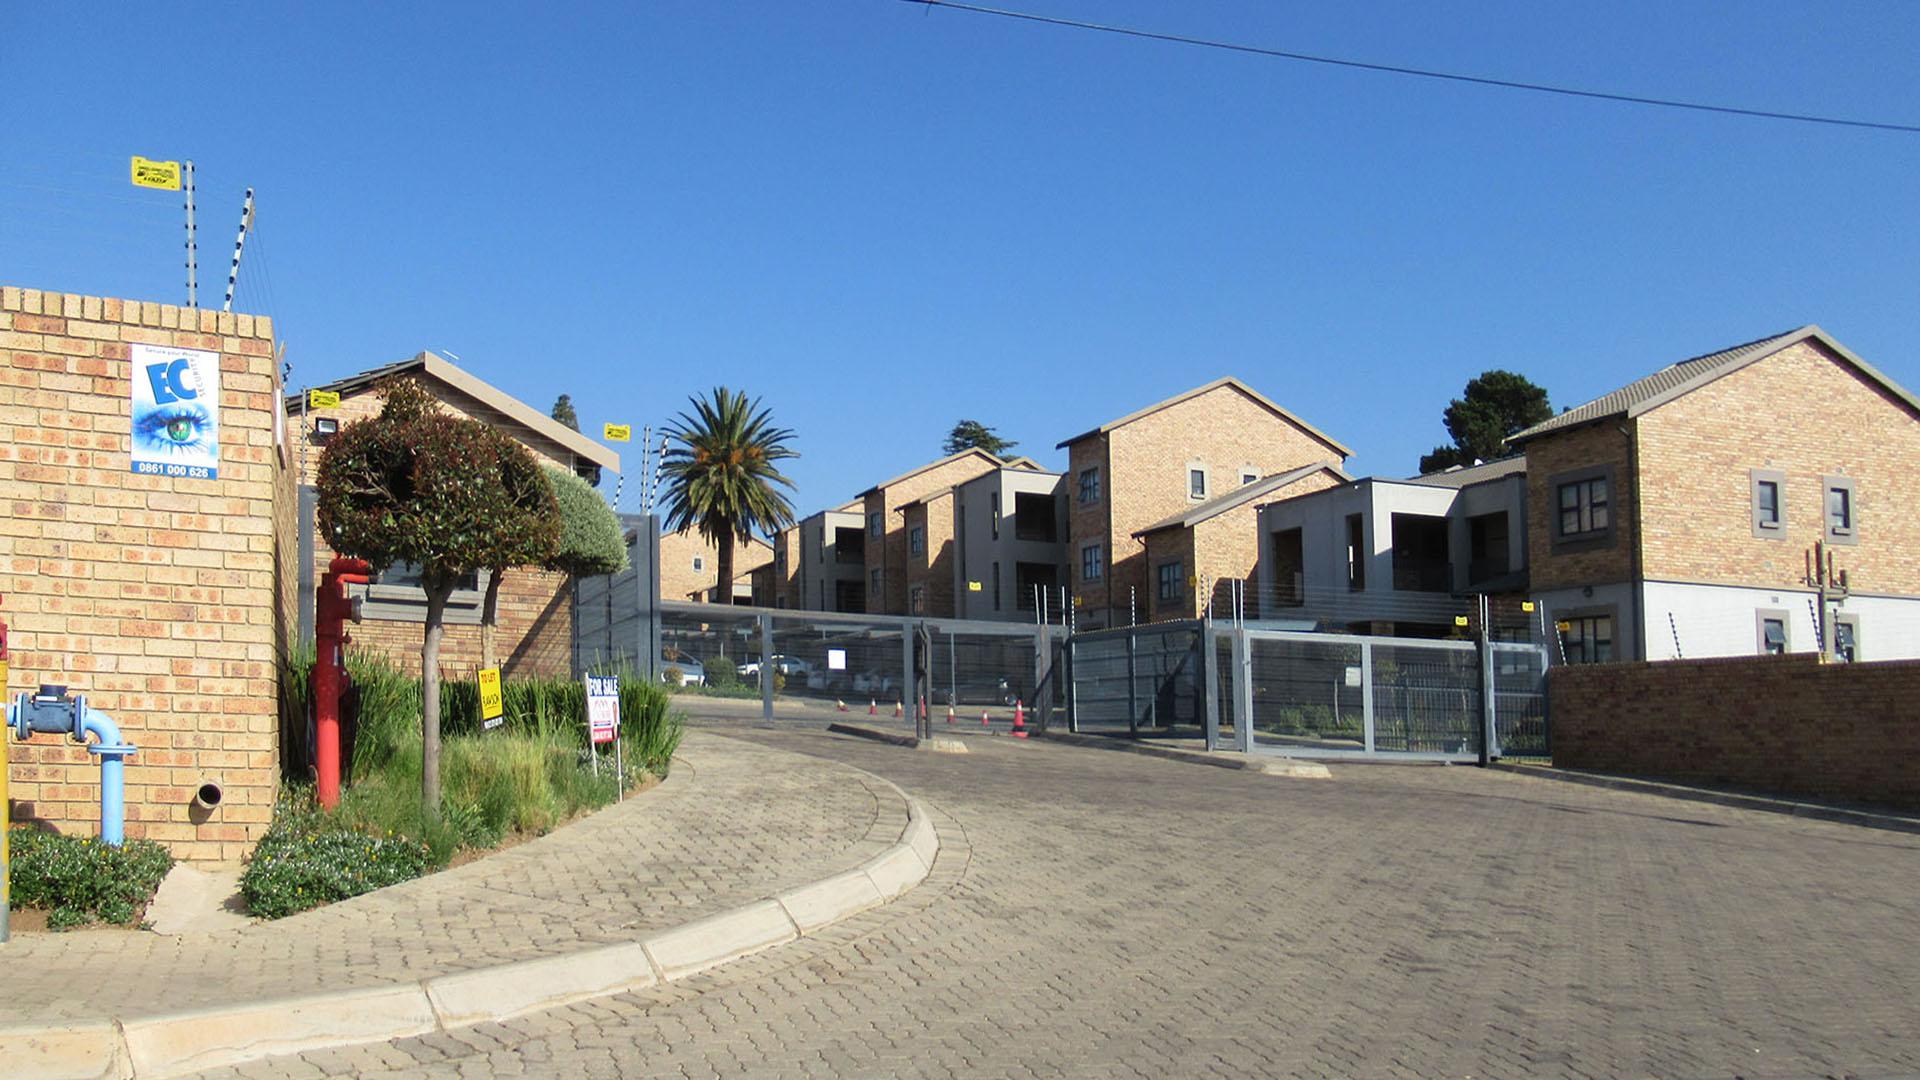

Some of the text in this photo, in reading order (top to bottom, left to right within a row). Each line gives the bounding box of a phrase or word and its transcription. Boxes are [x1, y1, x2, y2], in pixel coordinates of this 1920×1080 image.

[145, 358, 198, 405] EC
[139, 462, 208, 477] 0861 000 626
[590, 678, 618, 695] FOR SALE
